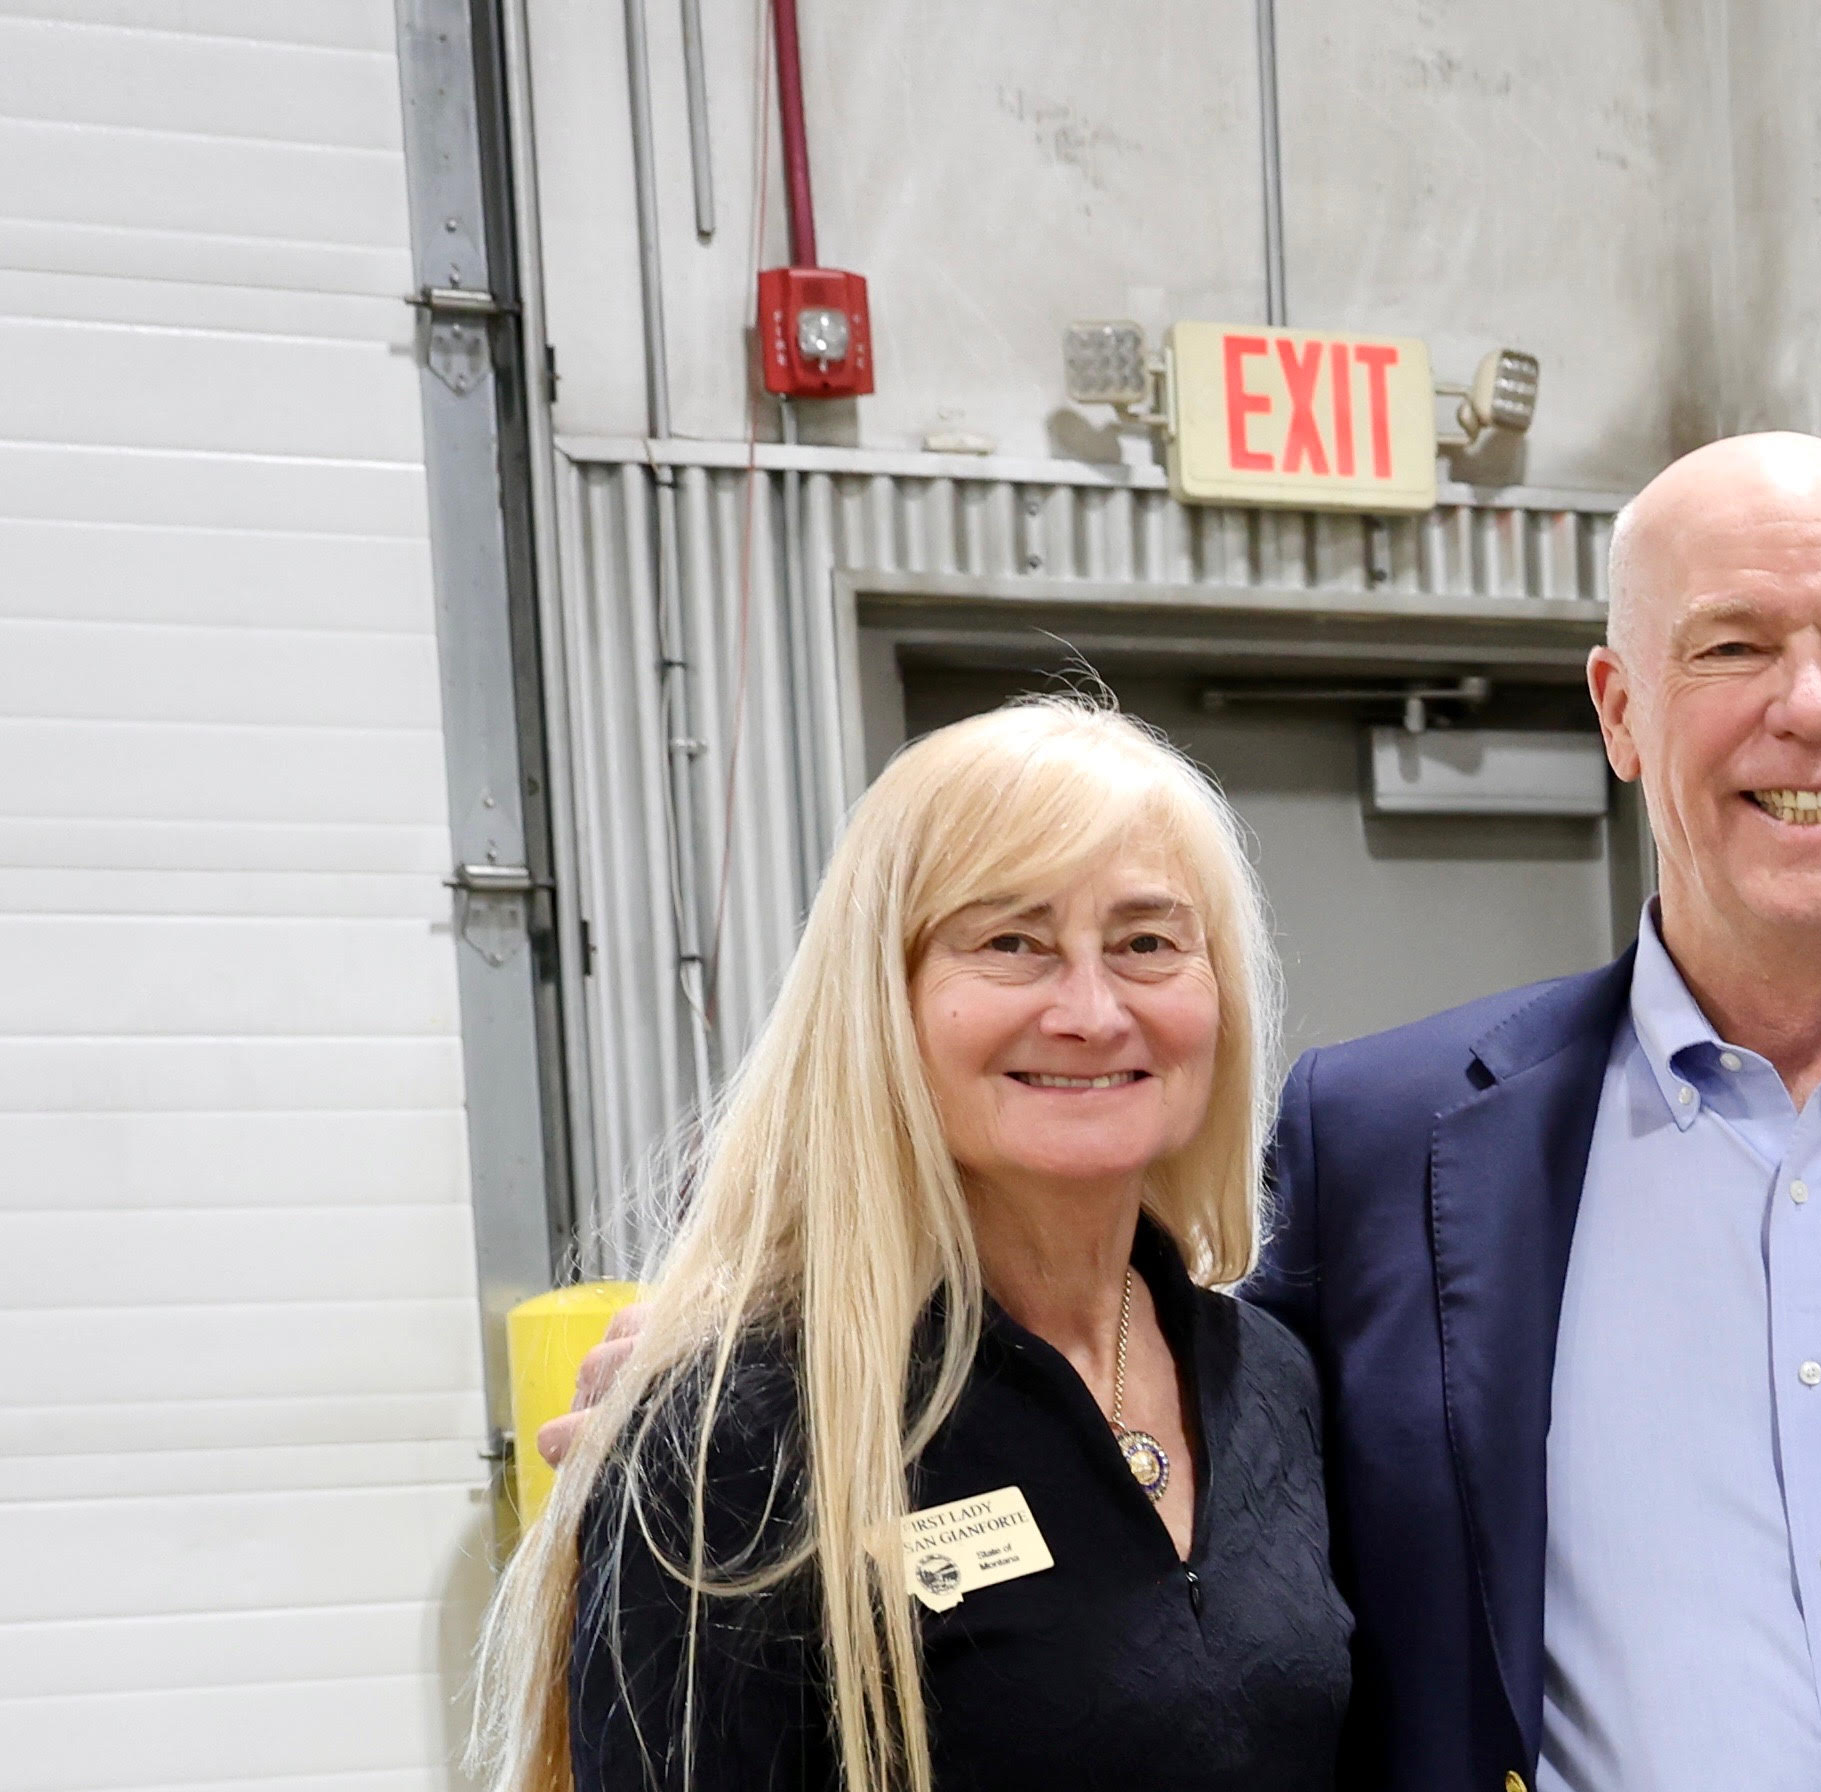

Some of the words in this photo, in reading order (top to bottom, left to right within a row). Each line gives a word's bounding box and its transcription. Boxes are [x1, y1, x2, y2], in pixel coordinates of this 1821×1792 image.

[1223, 334, 1400, 479] EXIT
[903, 1514, 947, 1532] IRST
[951, 1501, 992, 1523] LADY
[940, 1512, 1028, 1545] GIANFORTE
